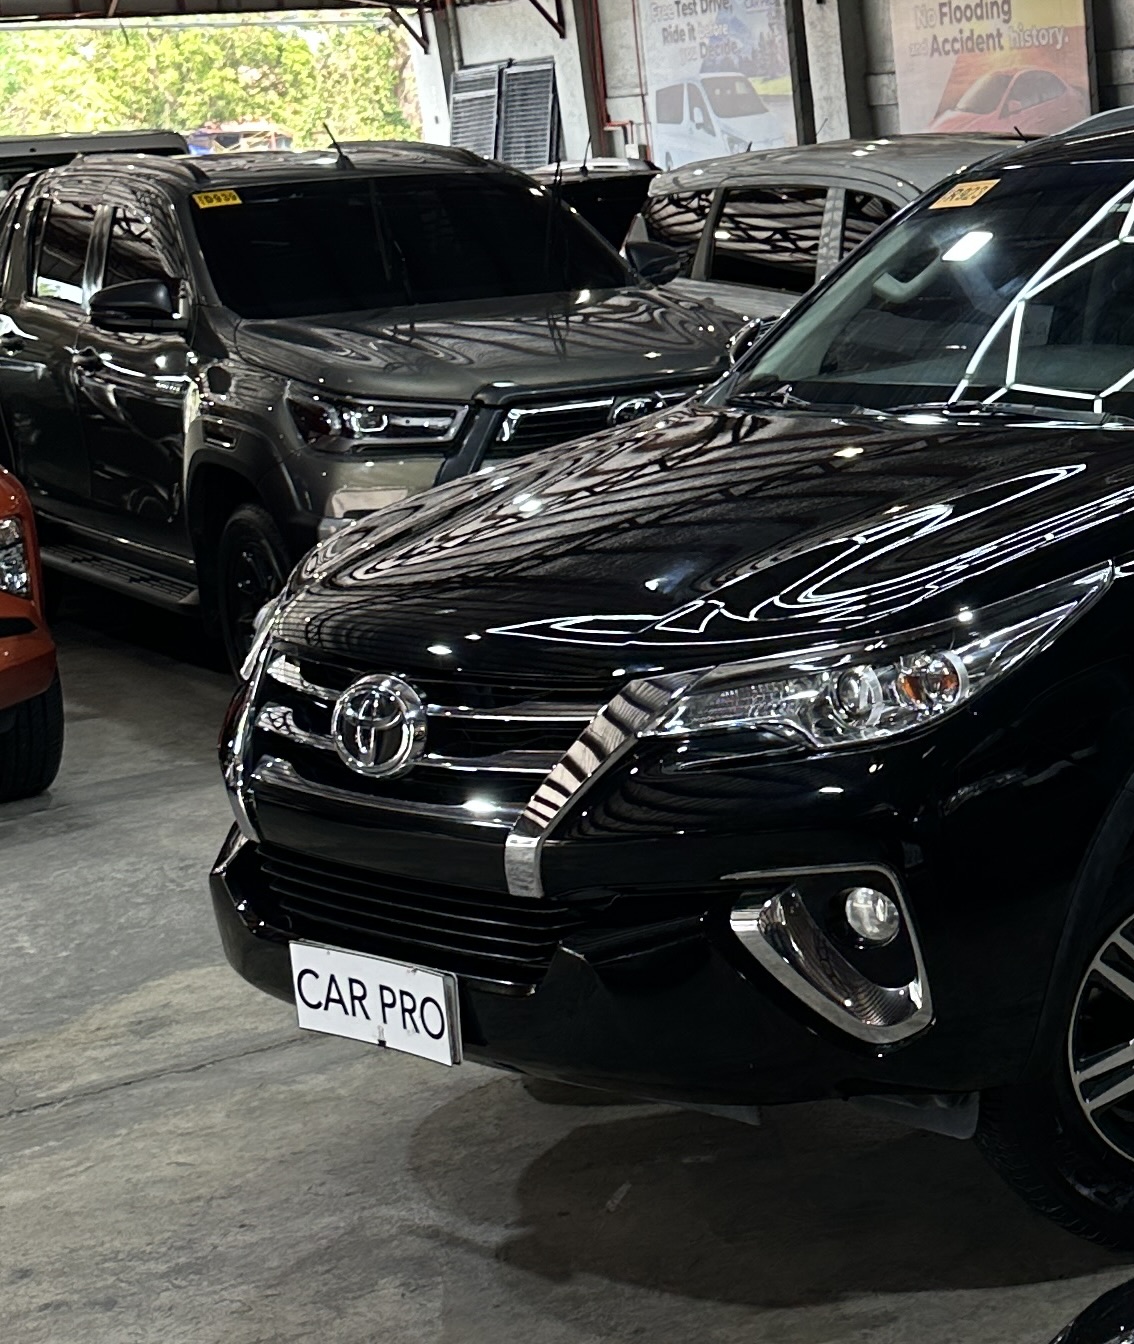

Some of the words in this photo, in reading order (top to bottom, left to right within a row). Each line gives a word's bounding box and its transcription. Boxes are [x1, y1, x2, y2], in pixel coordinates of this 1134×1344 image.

[914, 4, 938, 30] No
[662, 23, 686, 45] Ride
[687, 22, 696, 41] it
[930, 28, 1004, 58] Accident
[1007, 22, 1070, 49] history.
[297, 968, 371, 1021] CAR
[379, 984, 445, 1040] PRO
